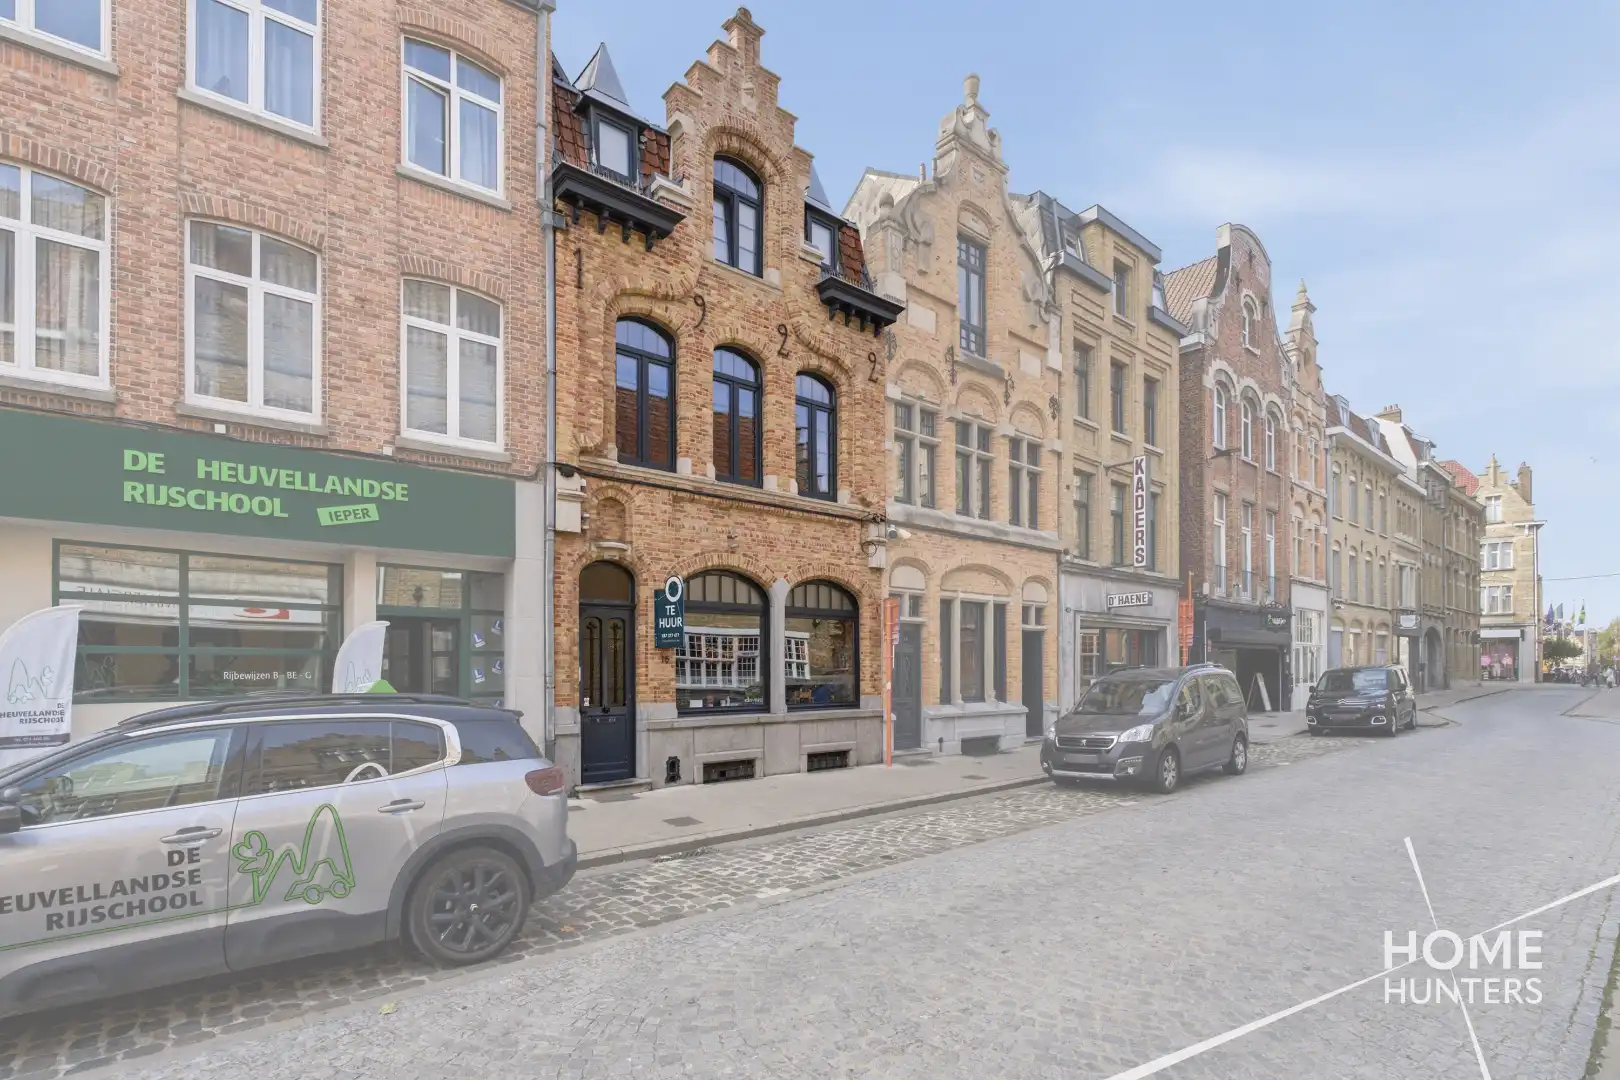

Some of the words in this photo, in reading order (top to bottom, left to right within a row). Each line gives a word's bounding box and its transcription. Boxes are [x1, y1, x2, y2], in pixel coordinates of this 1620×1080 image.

[123, 449, 165, 474] DE
[197, 458, 409, 501] HEUVELLANDSE
[123, 481, 289, 518] RIJSCHOOL
[328, 507, 372, 523] IEPER
[1135, 458, 1144, 564] KADERS
[665, 605, 676, 616] TE
[659, 617, 683, 629] HUUR
[223, 671, 271, 681] Rijbewijzen
[273, 671, 279, 680] B
[286, 671, 297, 680] BE
[167, 848, 201, 867] DE
[46, 890, 204, 932] RIJSCHOOL
